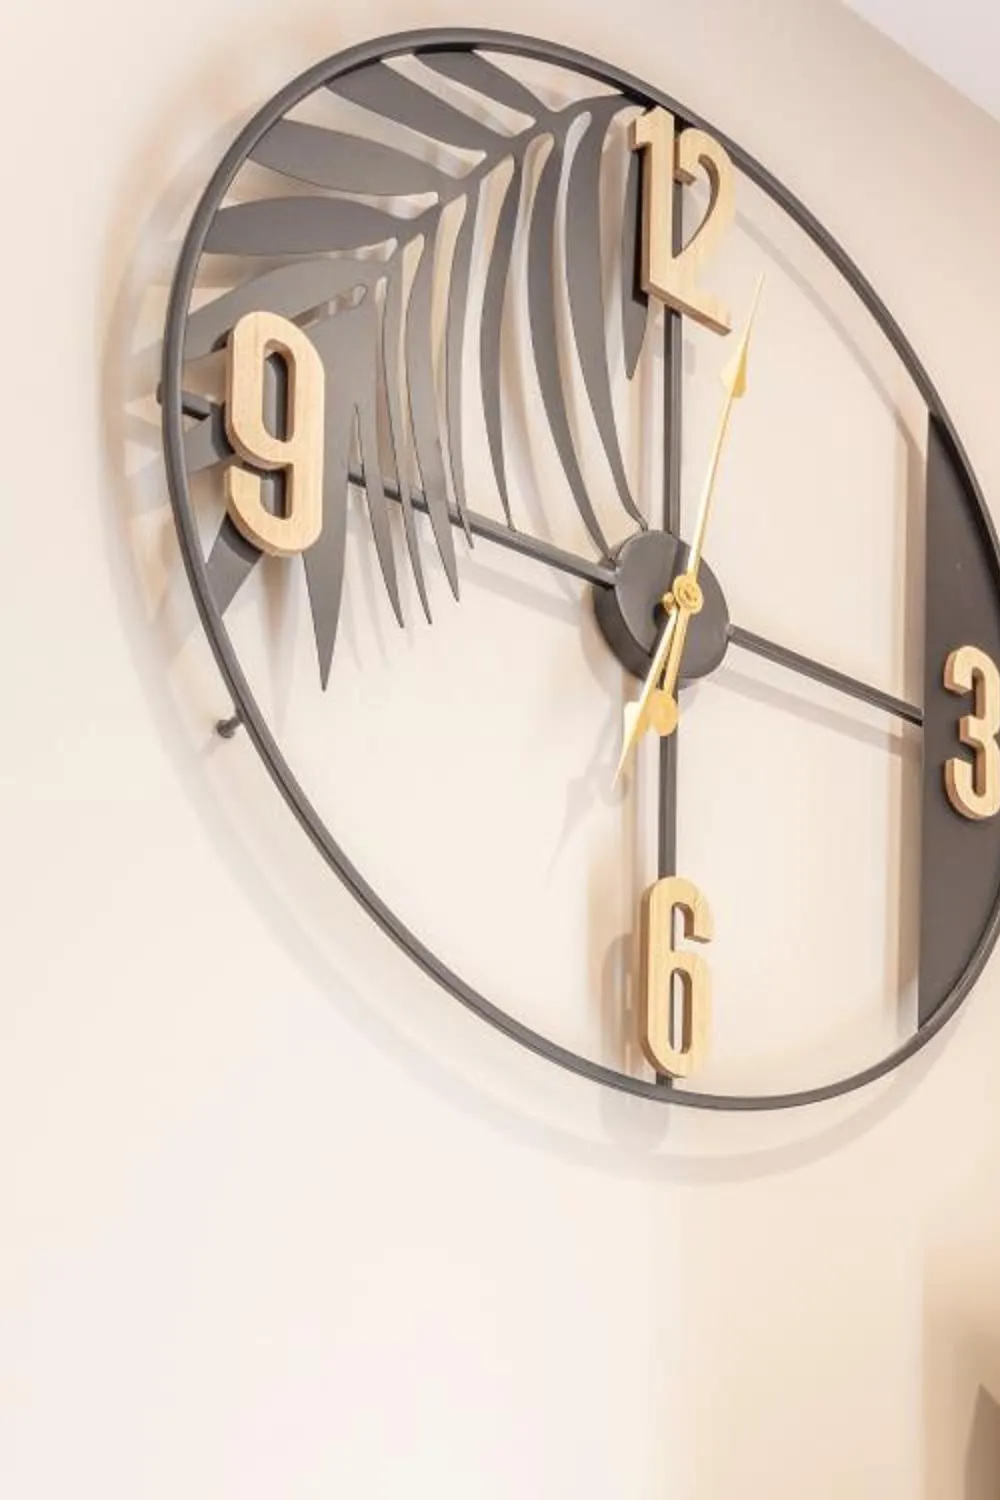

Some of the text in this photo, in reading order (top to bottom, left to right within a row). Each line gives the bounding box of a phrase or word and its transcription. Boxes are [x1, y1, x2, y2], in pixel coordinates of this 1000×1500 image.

[628, 107, 734, 335] 12
[226, 311, 325, 557] 9
[640, 876, 714, 1077] 6
